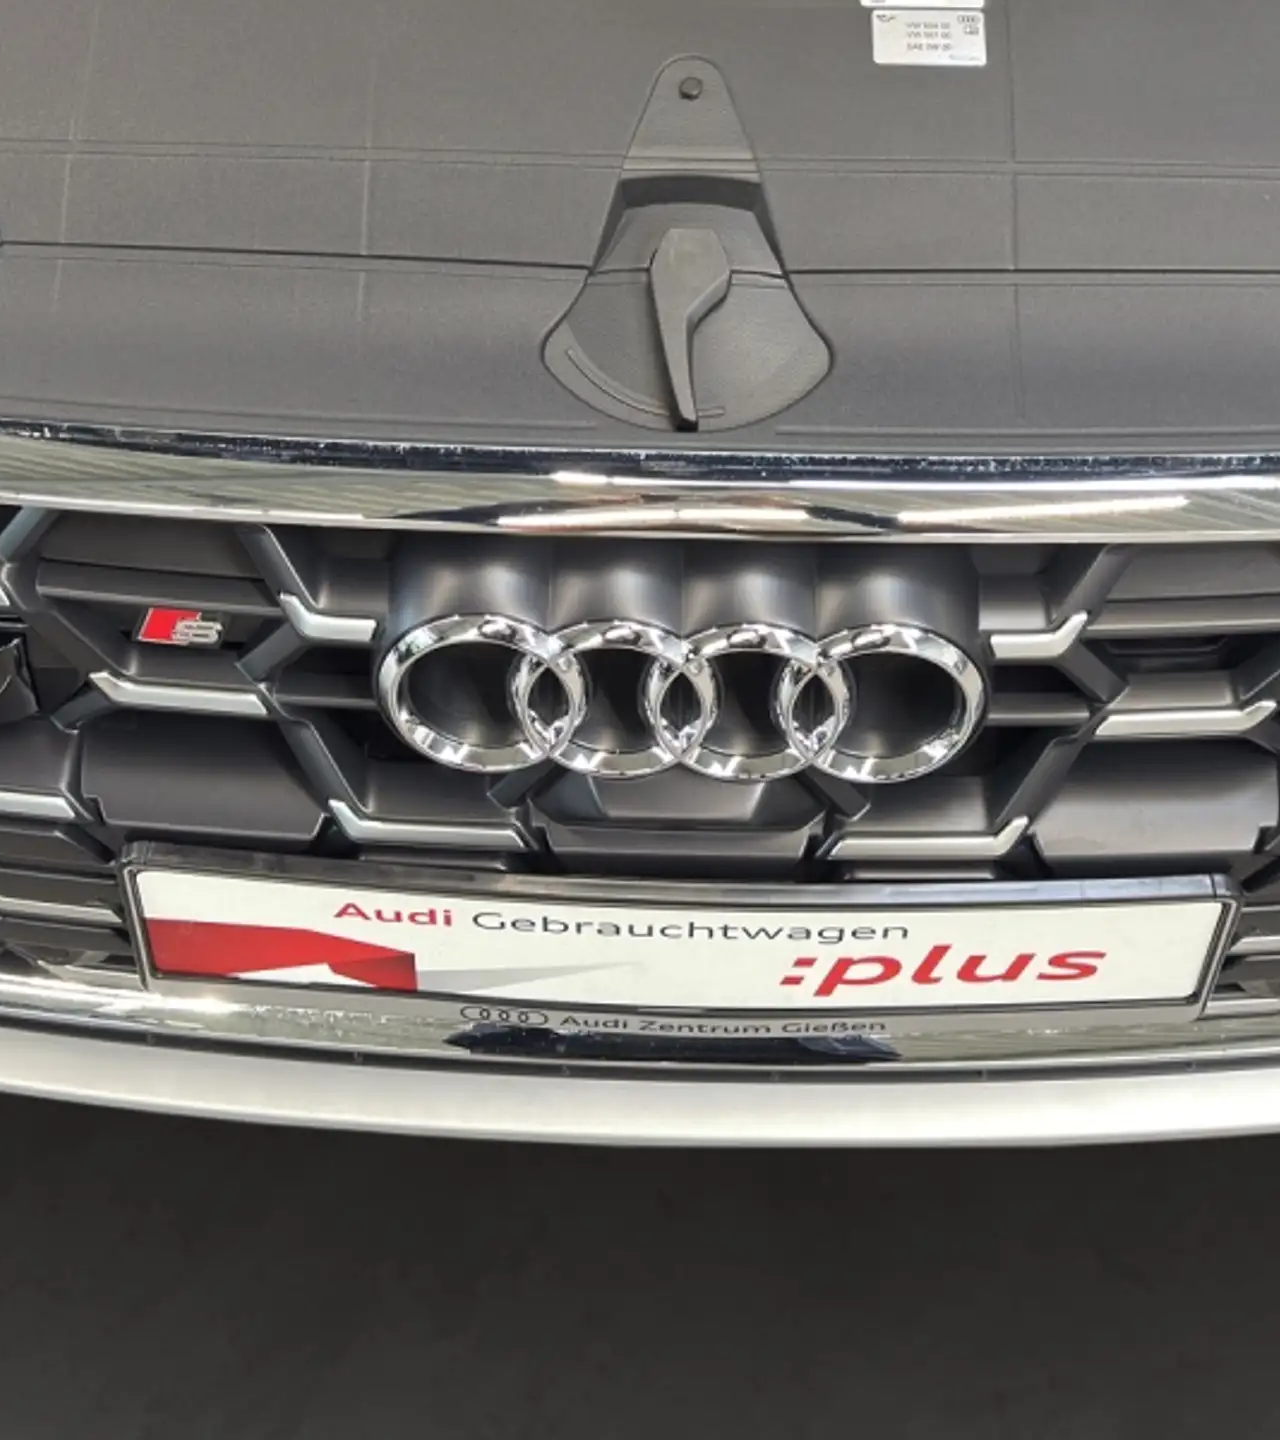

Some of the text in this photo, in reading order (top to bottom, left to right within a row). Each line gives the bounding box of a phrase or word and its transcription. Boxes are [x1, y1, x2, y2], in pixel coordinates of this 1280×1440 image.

[333, 901, 909, 945] Audi Gebrauchtwagen
[779, 943, 1107, 998] :plus
[559, 1015, 888, 1035] Audi Zentrum Gießen
